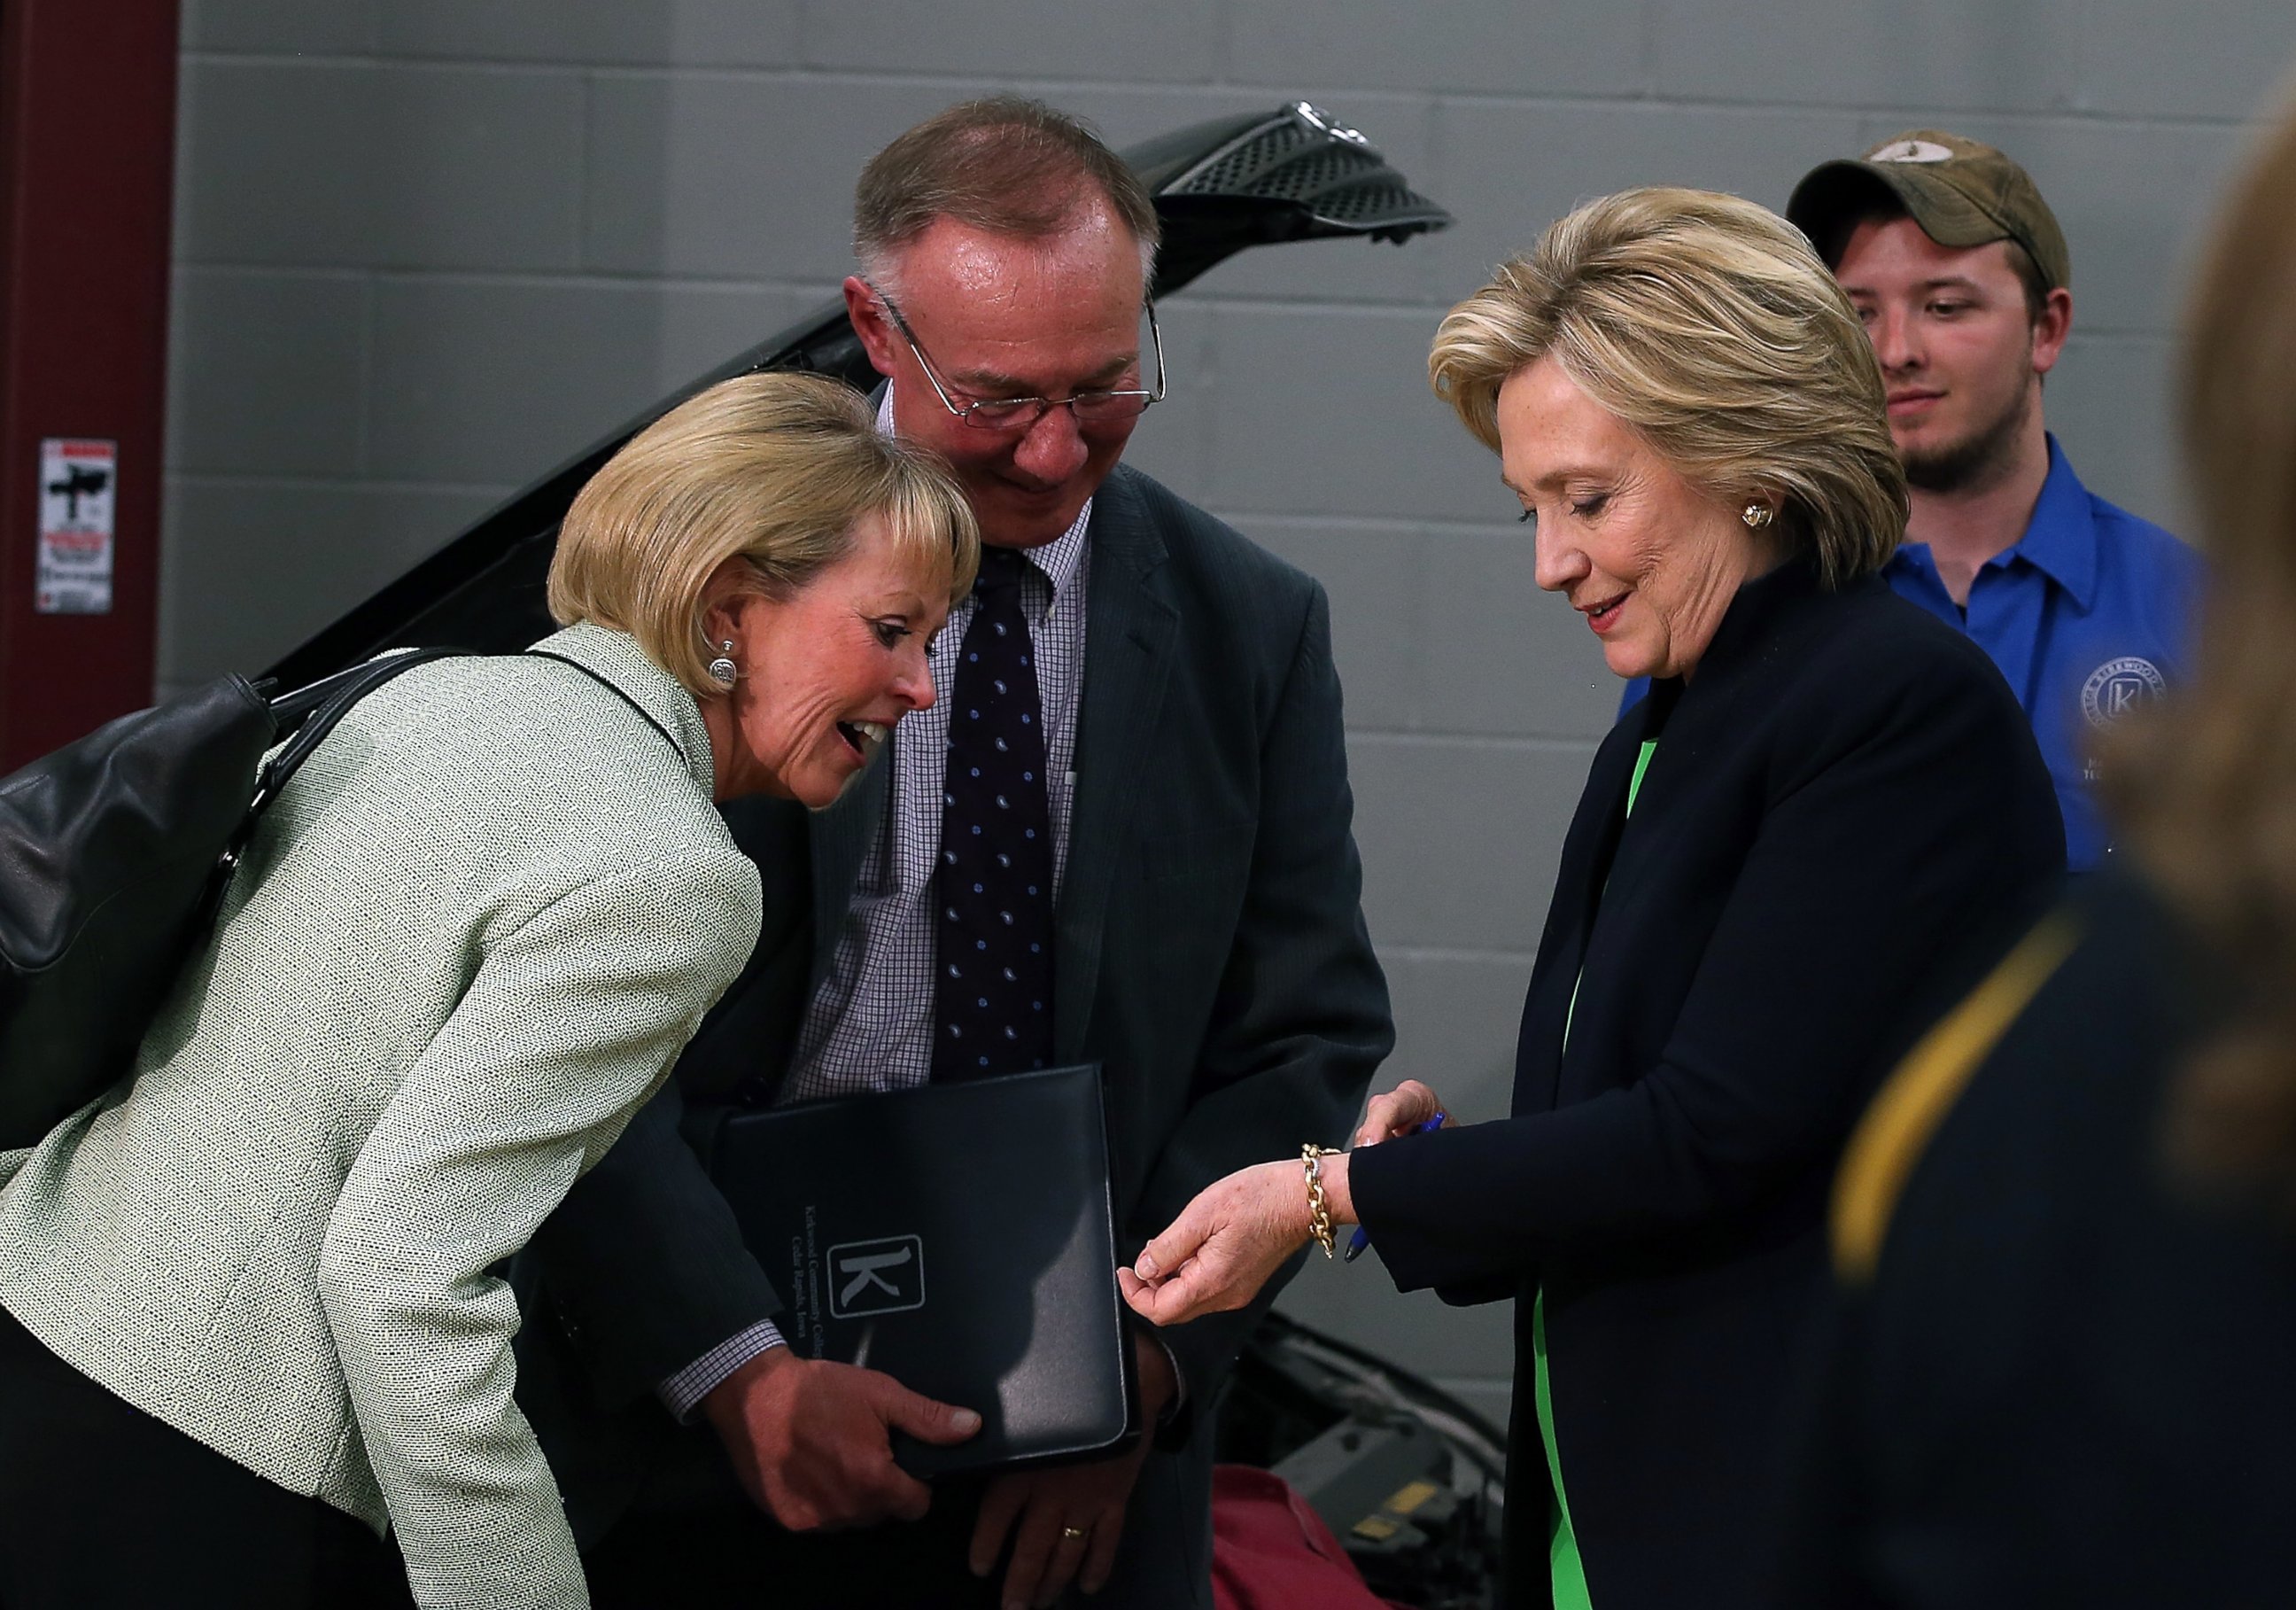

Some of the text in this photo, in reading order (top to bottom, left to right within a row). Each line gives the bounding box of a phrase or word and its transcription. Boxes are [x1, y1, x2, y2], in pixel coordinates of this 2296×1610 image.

[2114, 683, 2135, 712] K
[792, 1236, 807, 1338] Cedar Rapids, Iowa
[806, 1206, 823, 1358] Kirkwood Community Colleg
[840, 1246, 911, 1308] K
